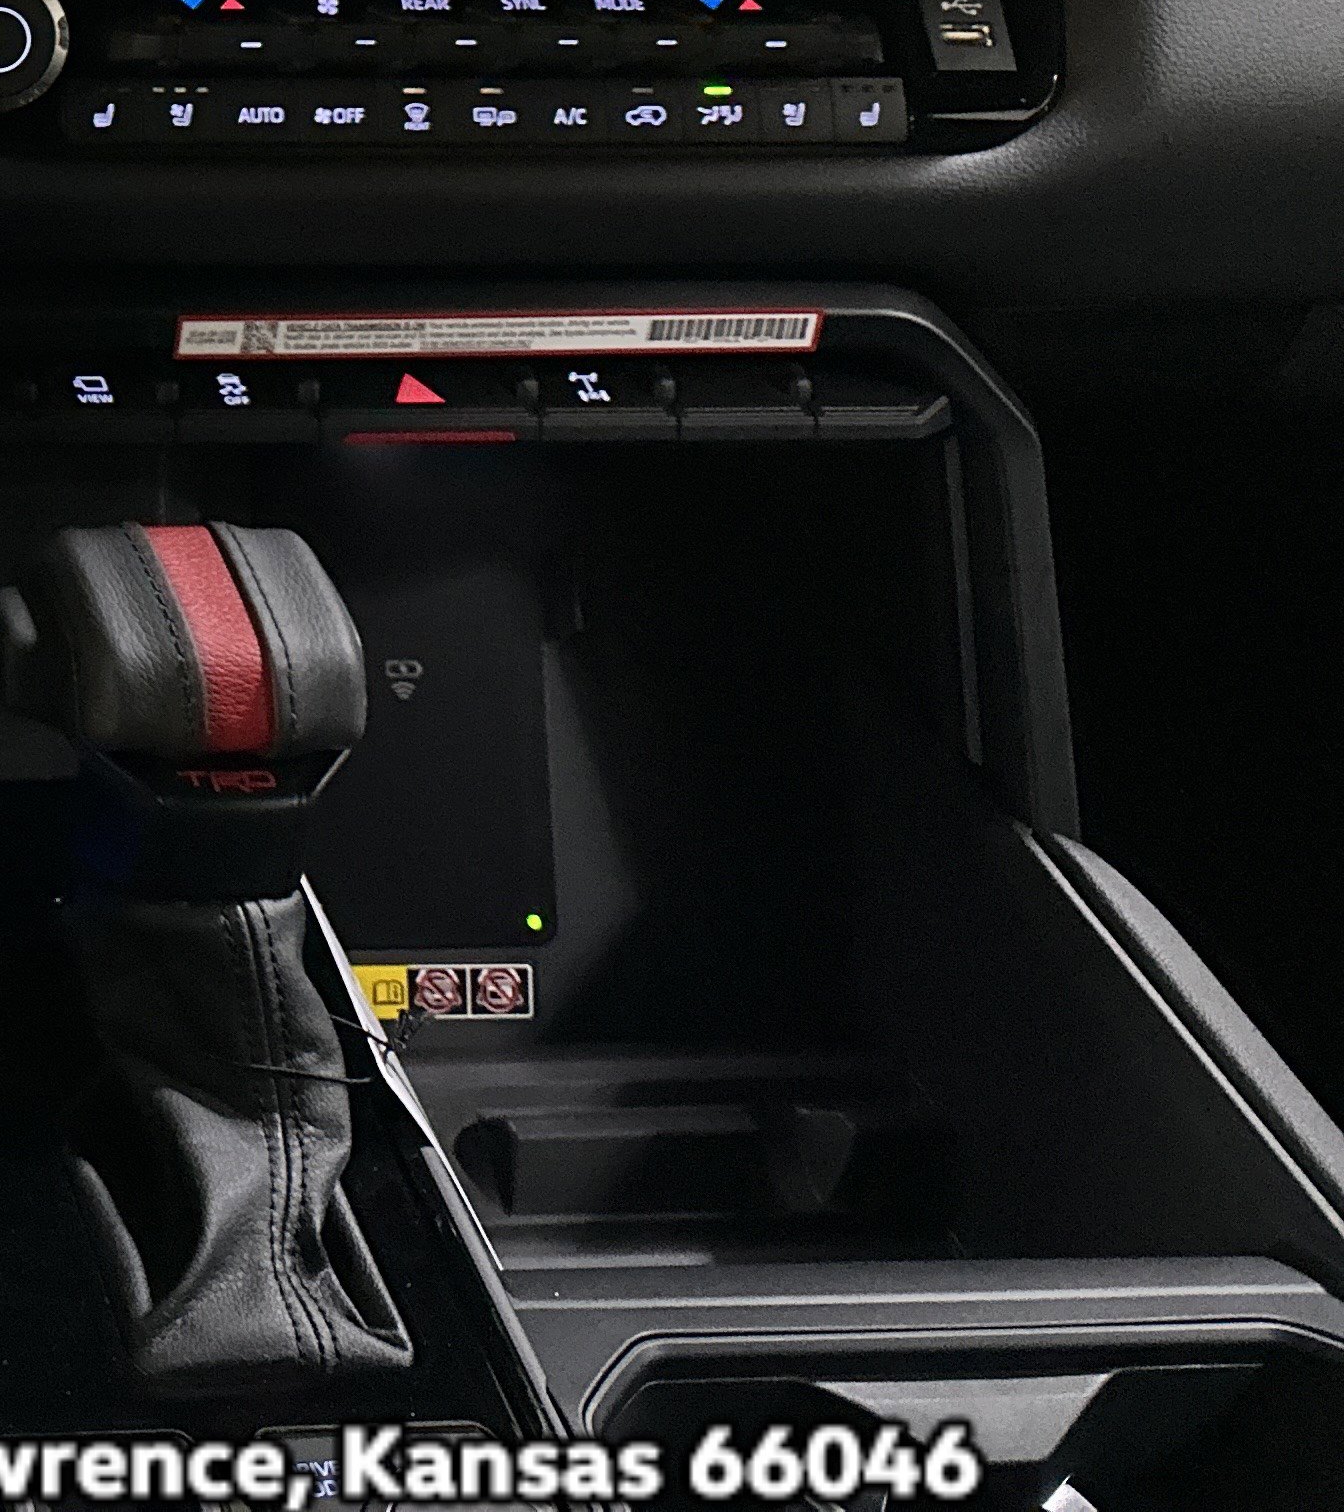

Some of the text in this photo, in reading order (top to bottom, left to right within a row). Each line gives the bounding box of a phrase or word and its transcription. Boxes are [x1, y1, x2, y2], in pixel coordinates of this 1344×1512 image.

[237, 106, 587, 125] AUTO OFF A/C
[176, 770, 276, 792] TRD
